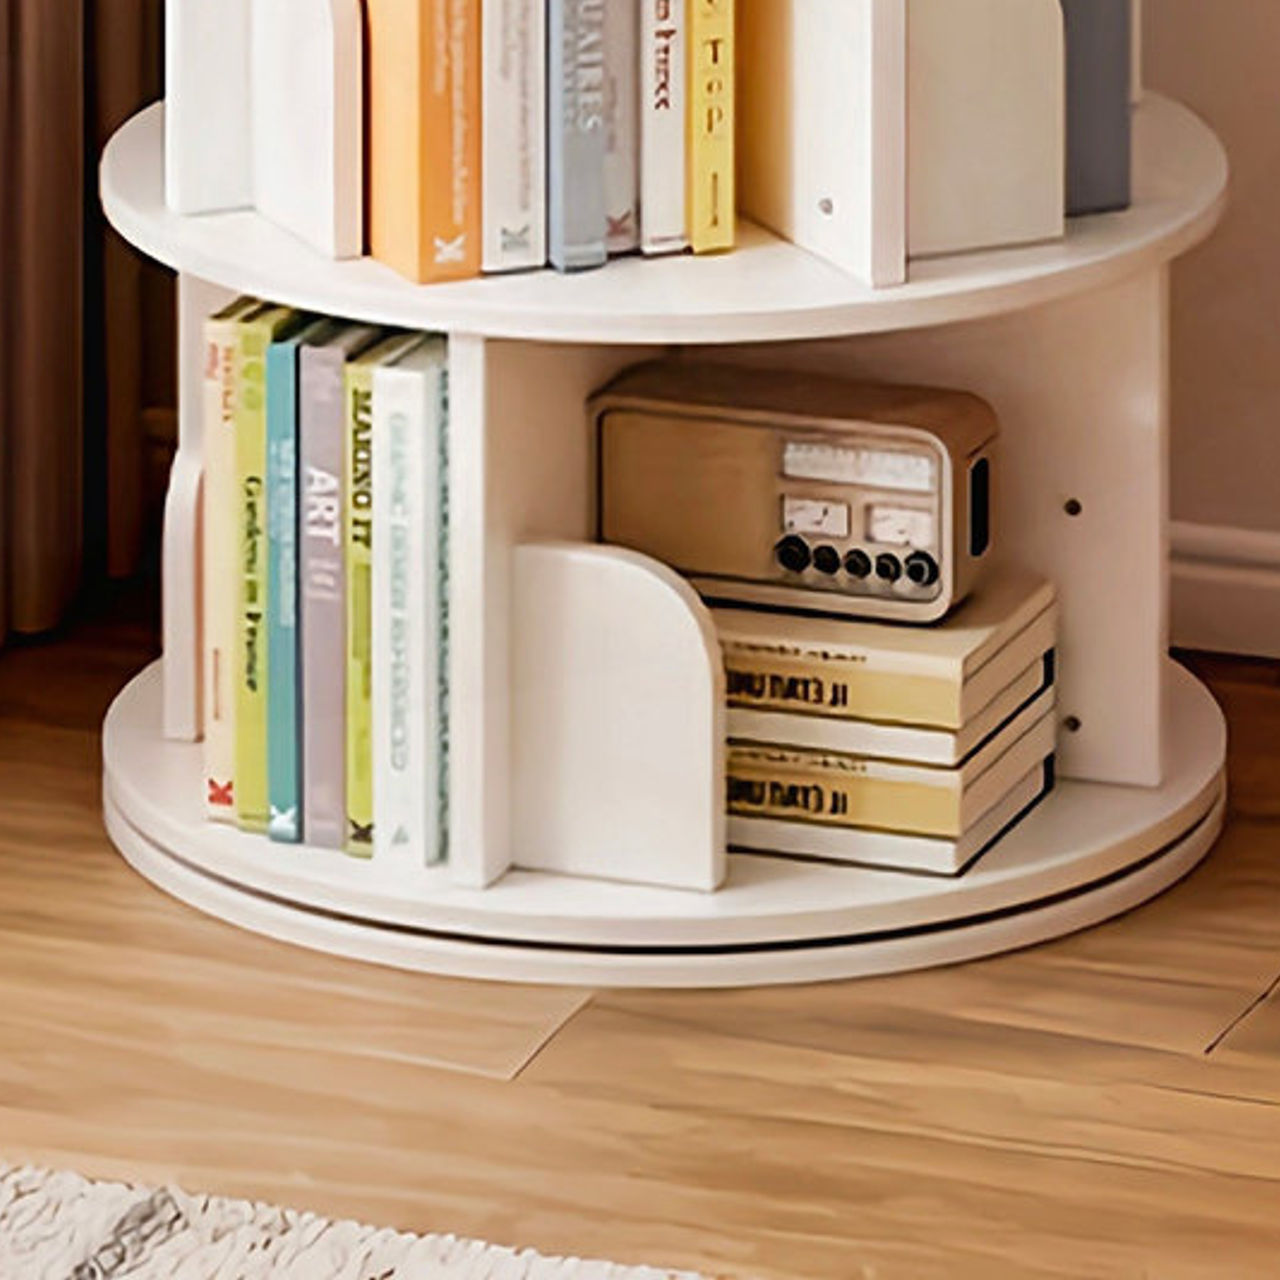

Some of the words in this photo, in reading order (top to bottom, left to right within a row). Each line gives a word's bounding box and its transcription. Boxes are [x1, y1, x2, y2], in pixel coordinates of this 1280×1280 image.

[352, 388, 372, 511] MAKING
[304, 466, 341, 548] ART
[352, 517, 372, 549] IT
